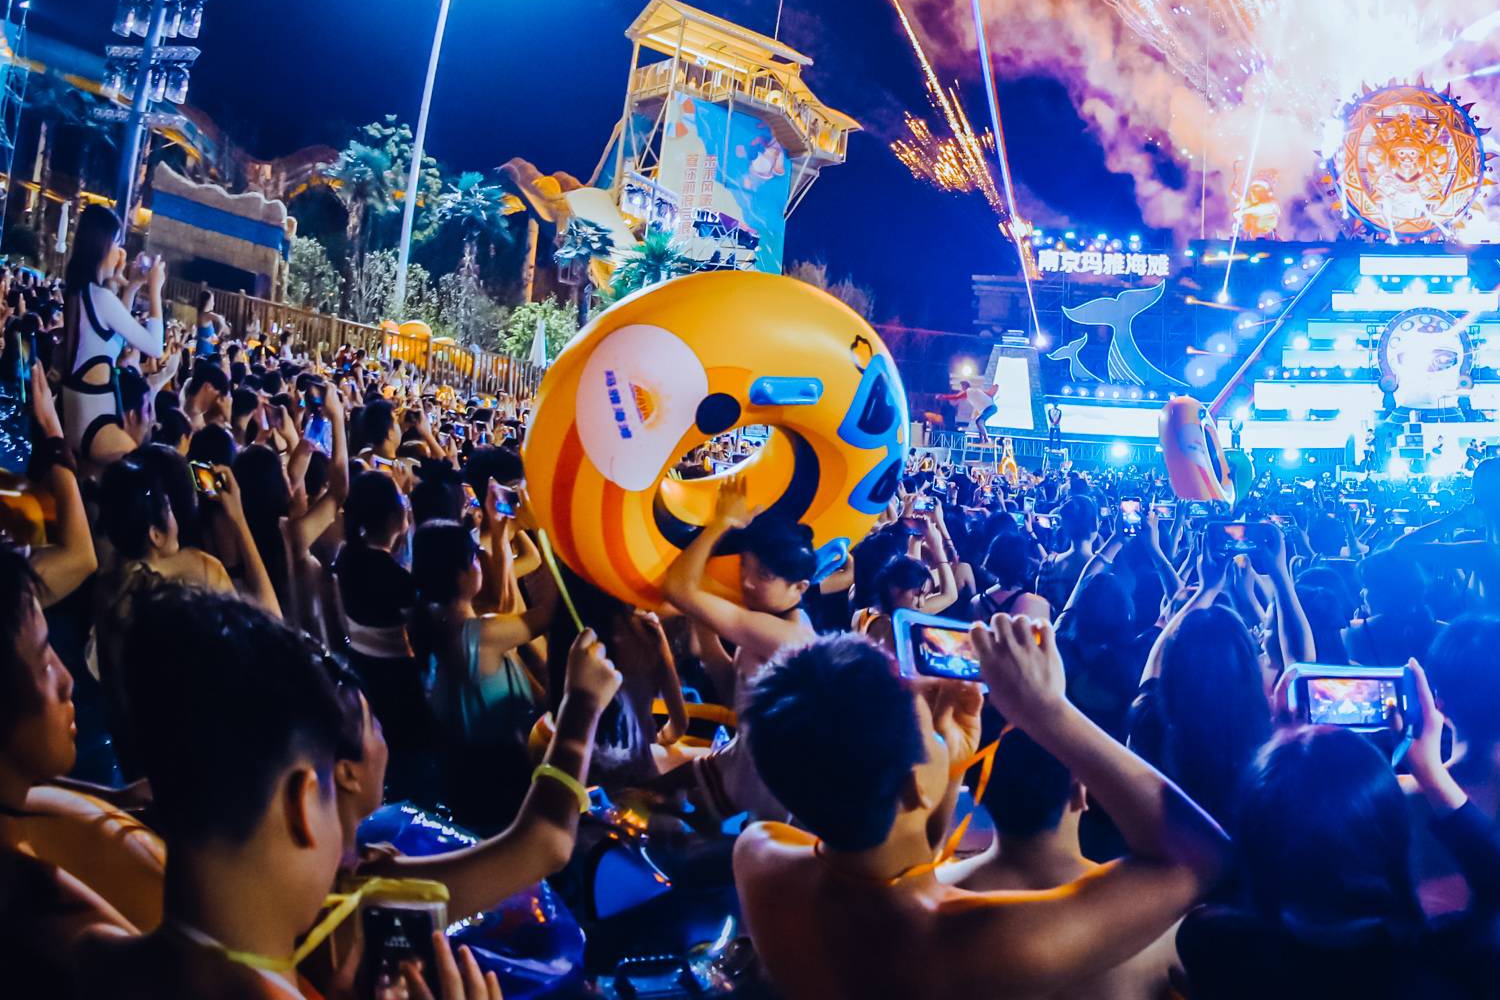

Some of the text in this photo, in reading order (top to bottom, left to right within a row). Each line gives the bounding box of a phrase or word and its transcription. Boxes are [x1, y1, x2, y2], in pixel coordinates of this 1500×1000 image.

[1038, 249, 1170, 276] 南京玛雅海滩
